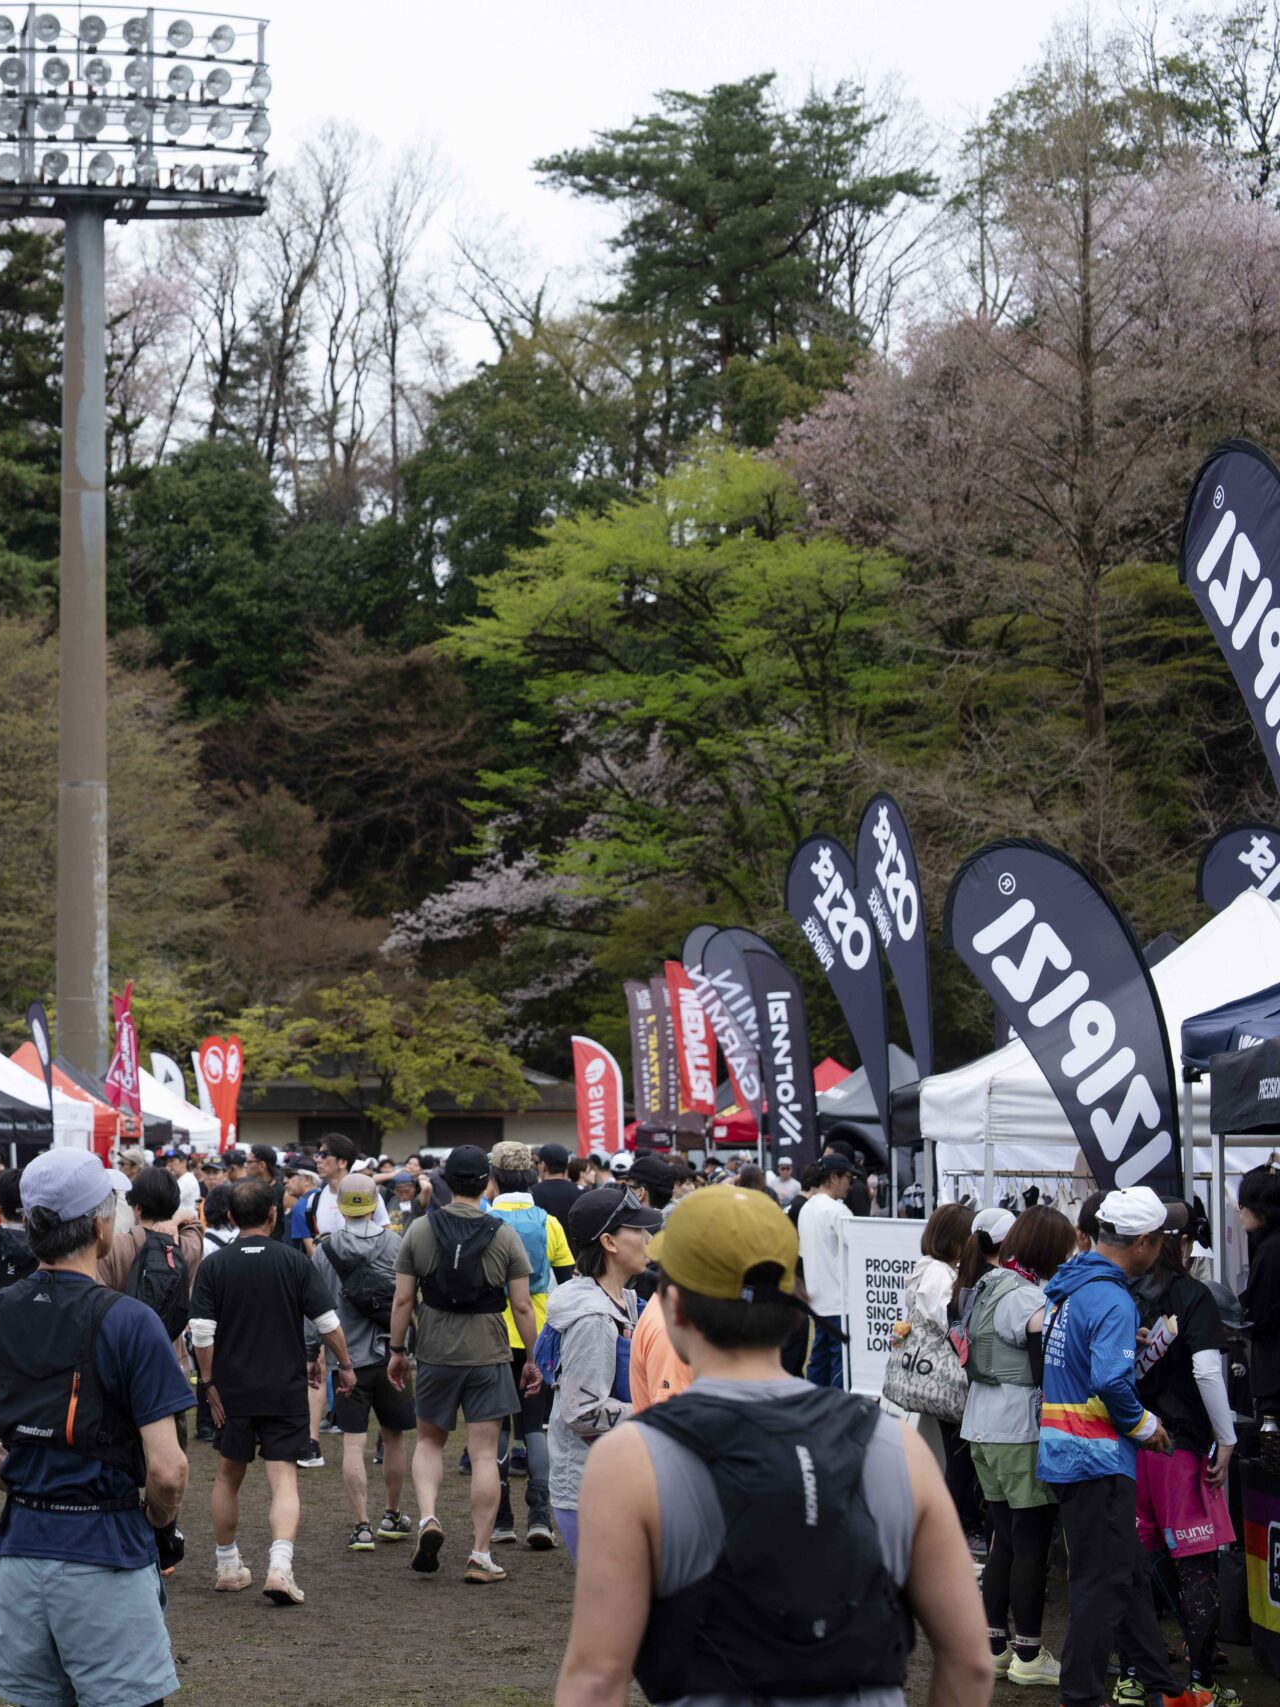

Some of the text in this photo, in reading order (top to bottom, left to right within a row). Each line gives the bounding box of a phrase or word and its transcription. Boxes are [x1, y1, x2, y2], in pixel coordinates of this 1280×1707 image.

[678, 987, 714, 1105] MEDALIST
[866, 1274, 908, 1290] RUNNI
[866, 1290, 898, 1305] CLUB
[866, 1306, 902, 1321] SINCE
[902, 1346, 933, 1375] alo
[16, 1424, 54, 1438] montrail
[795, 1445, 818, 1526] SALOMON
[50, 1504, 100, 1512] COMPRESSPO
